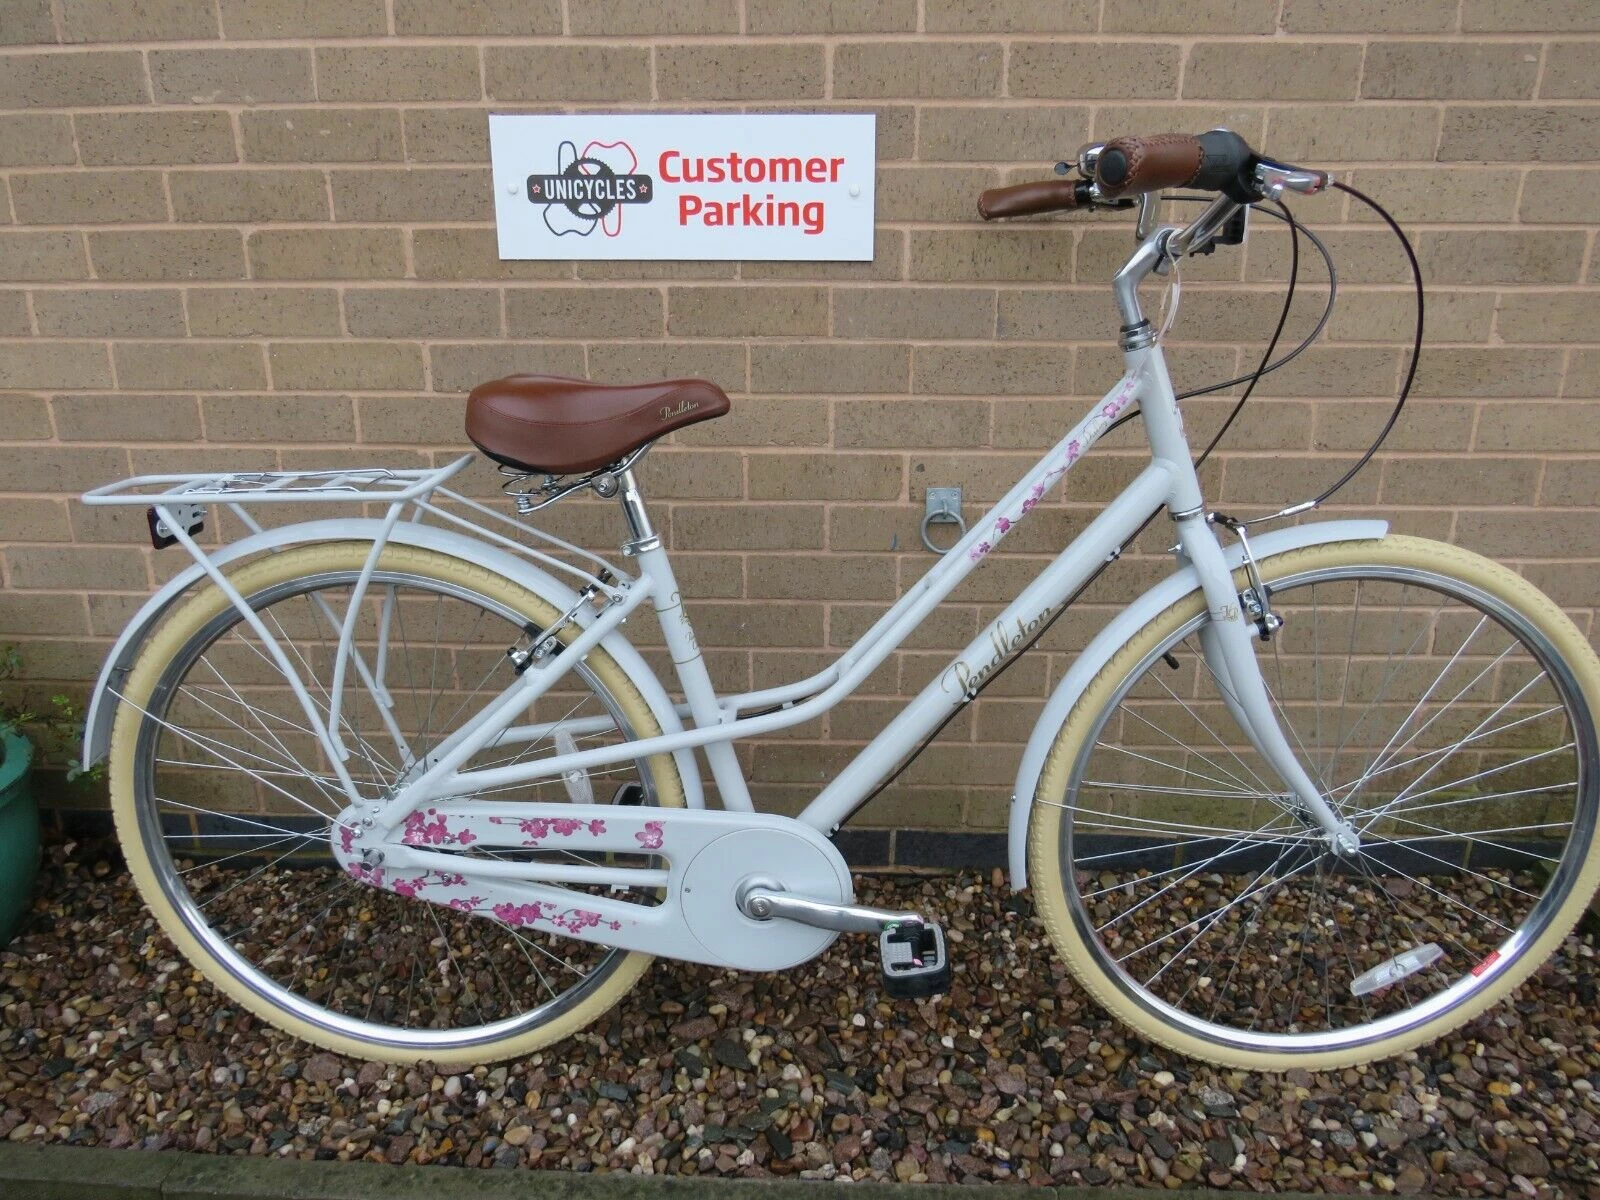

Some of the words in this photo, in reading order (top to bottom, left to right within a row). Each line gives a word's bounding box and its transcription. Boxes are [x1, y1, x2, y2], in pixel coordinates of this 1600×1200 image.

[658, 151, 845, 183] Customer
[544, 178, 637, 200] UNICYCLES
[679, 194, 825, 235] Parking
[660, 400, 700, 420] Pendleton
[941, 607, 1051, 704] Pendleton
